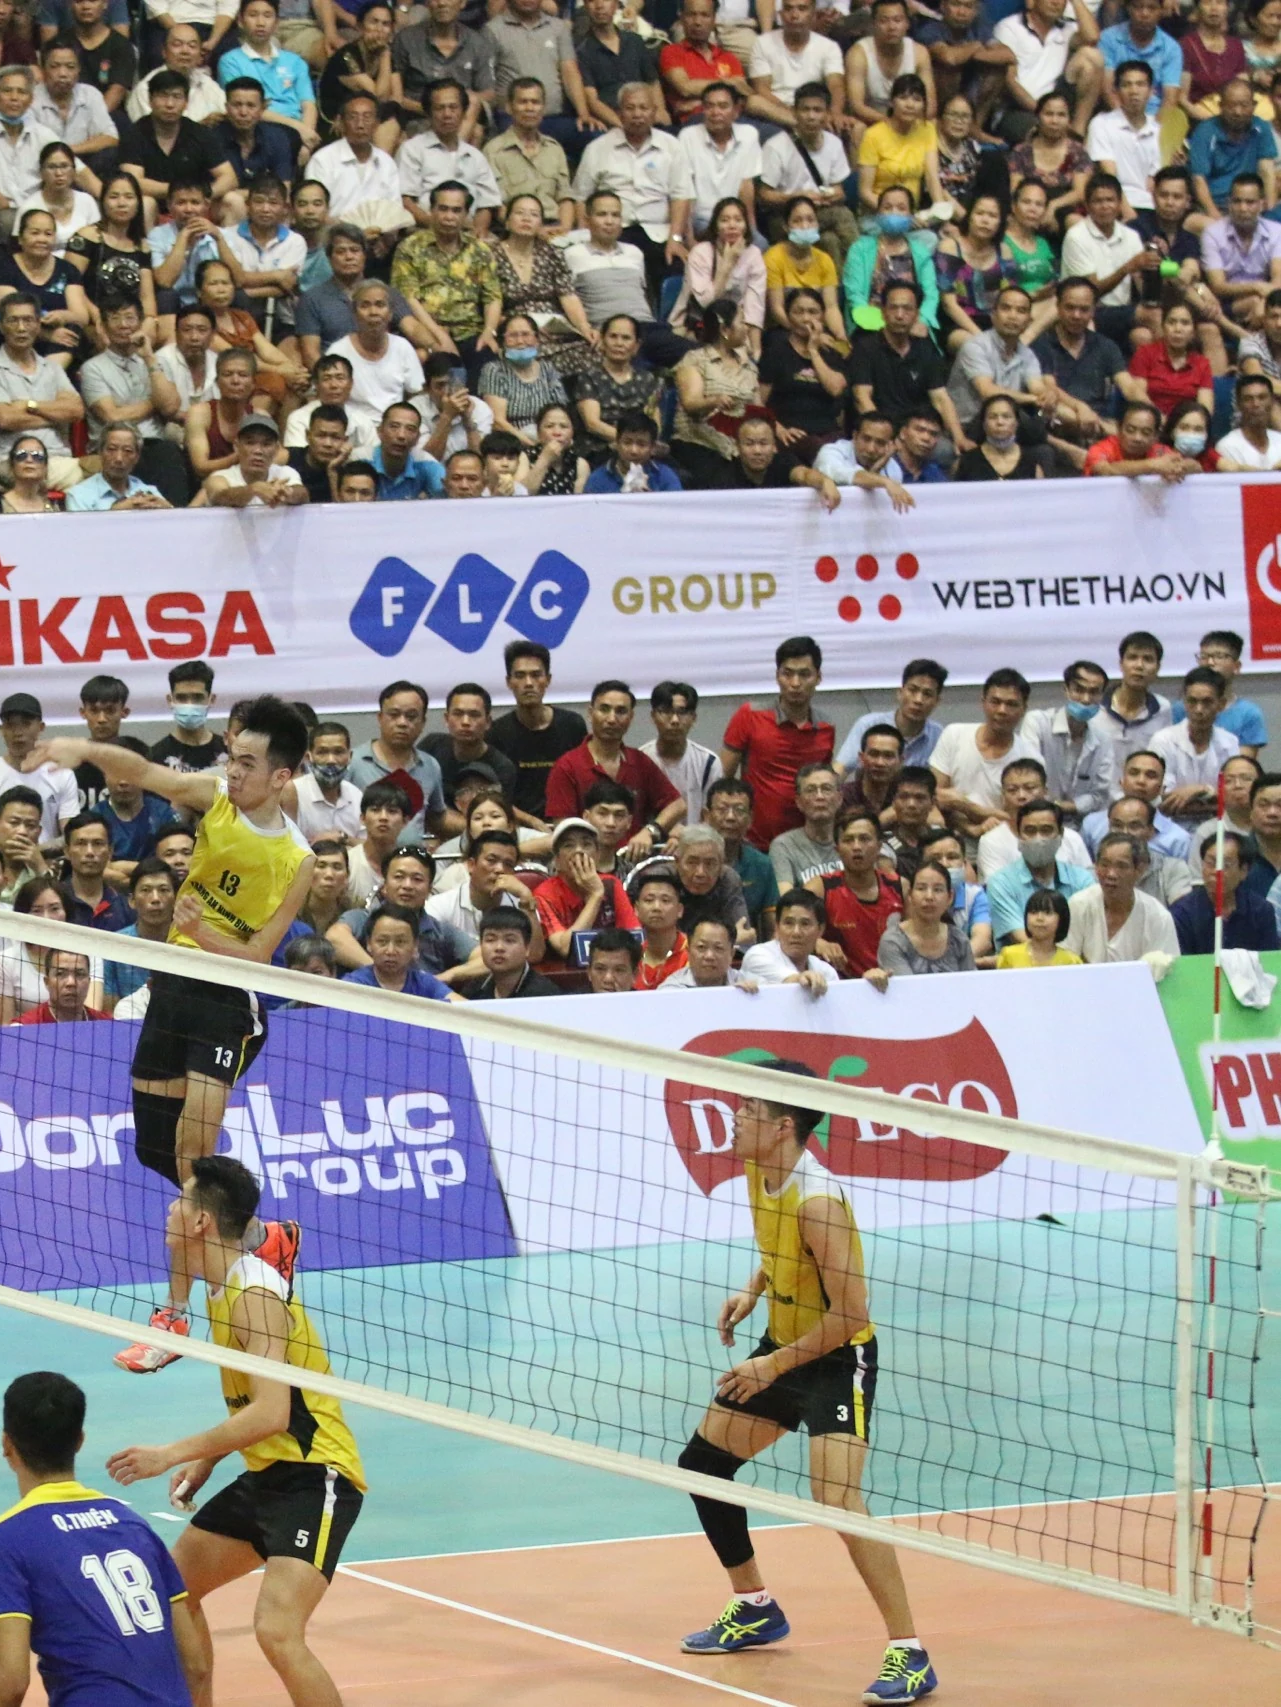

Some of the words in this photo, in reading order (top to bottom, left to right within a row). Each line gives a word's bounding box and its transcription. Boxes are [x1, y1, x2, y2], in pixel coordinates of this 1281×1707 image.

[611, 572, 777, 615] GROUP
[932, 571, 1226, 611] WEBTHETHAO.VN
[217, 869, 241, 897] 13
[214, 1046, 234, 1068] 13
[260, 1148, 468, 1200] roup
[836, 1405, 849, 1422] 3
[295, 1529, 310, 1549] 5
[80, 1549, 165, 1636] 18
